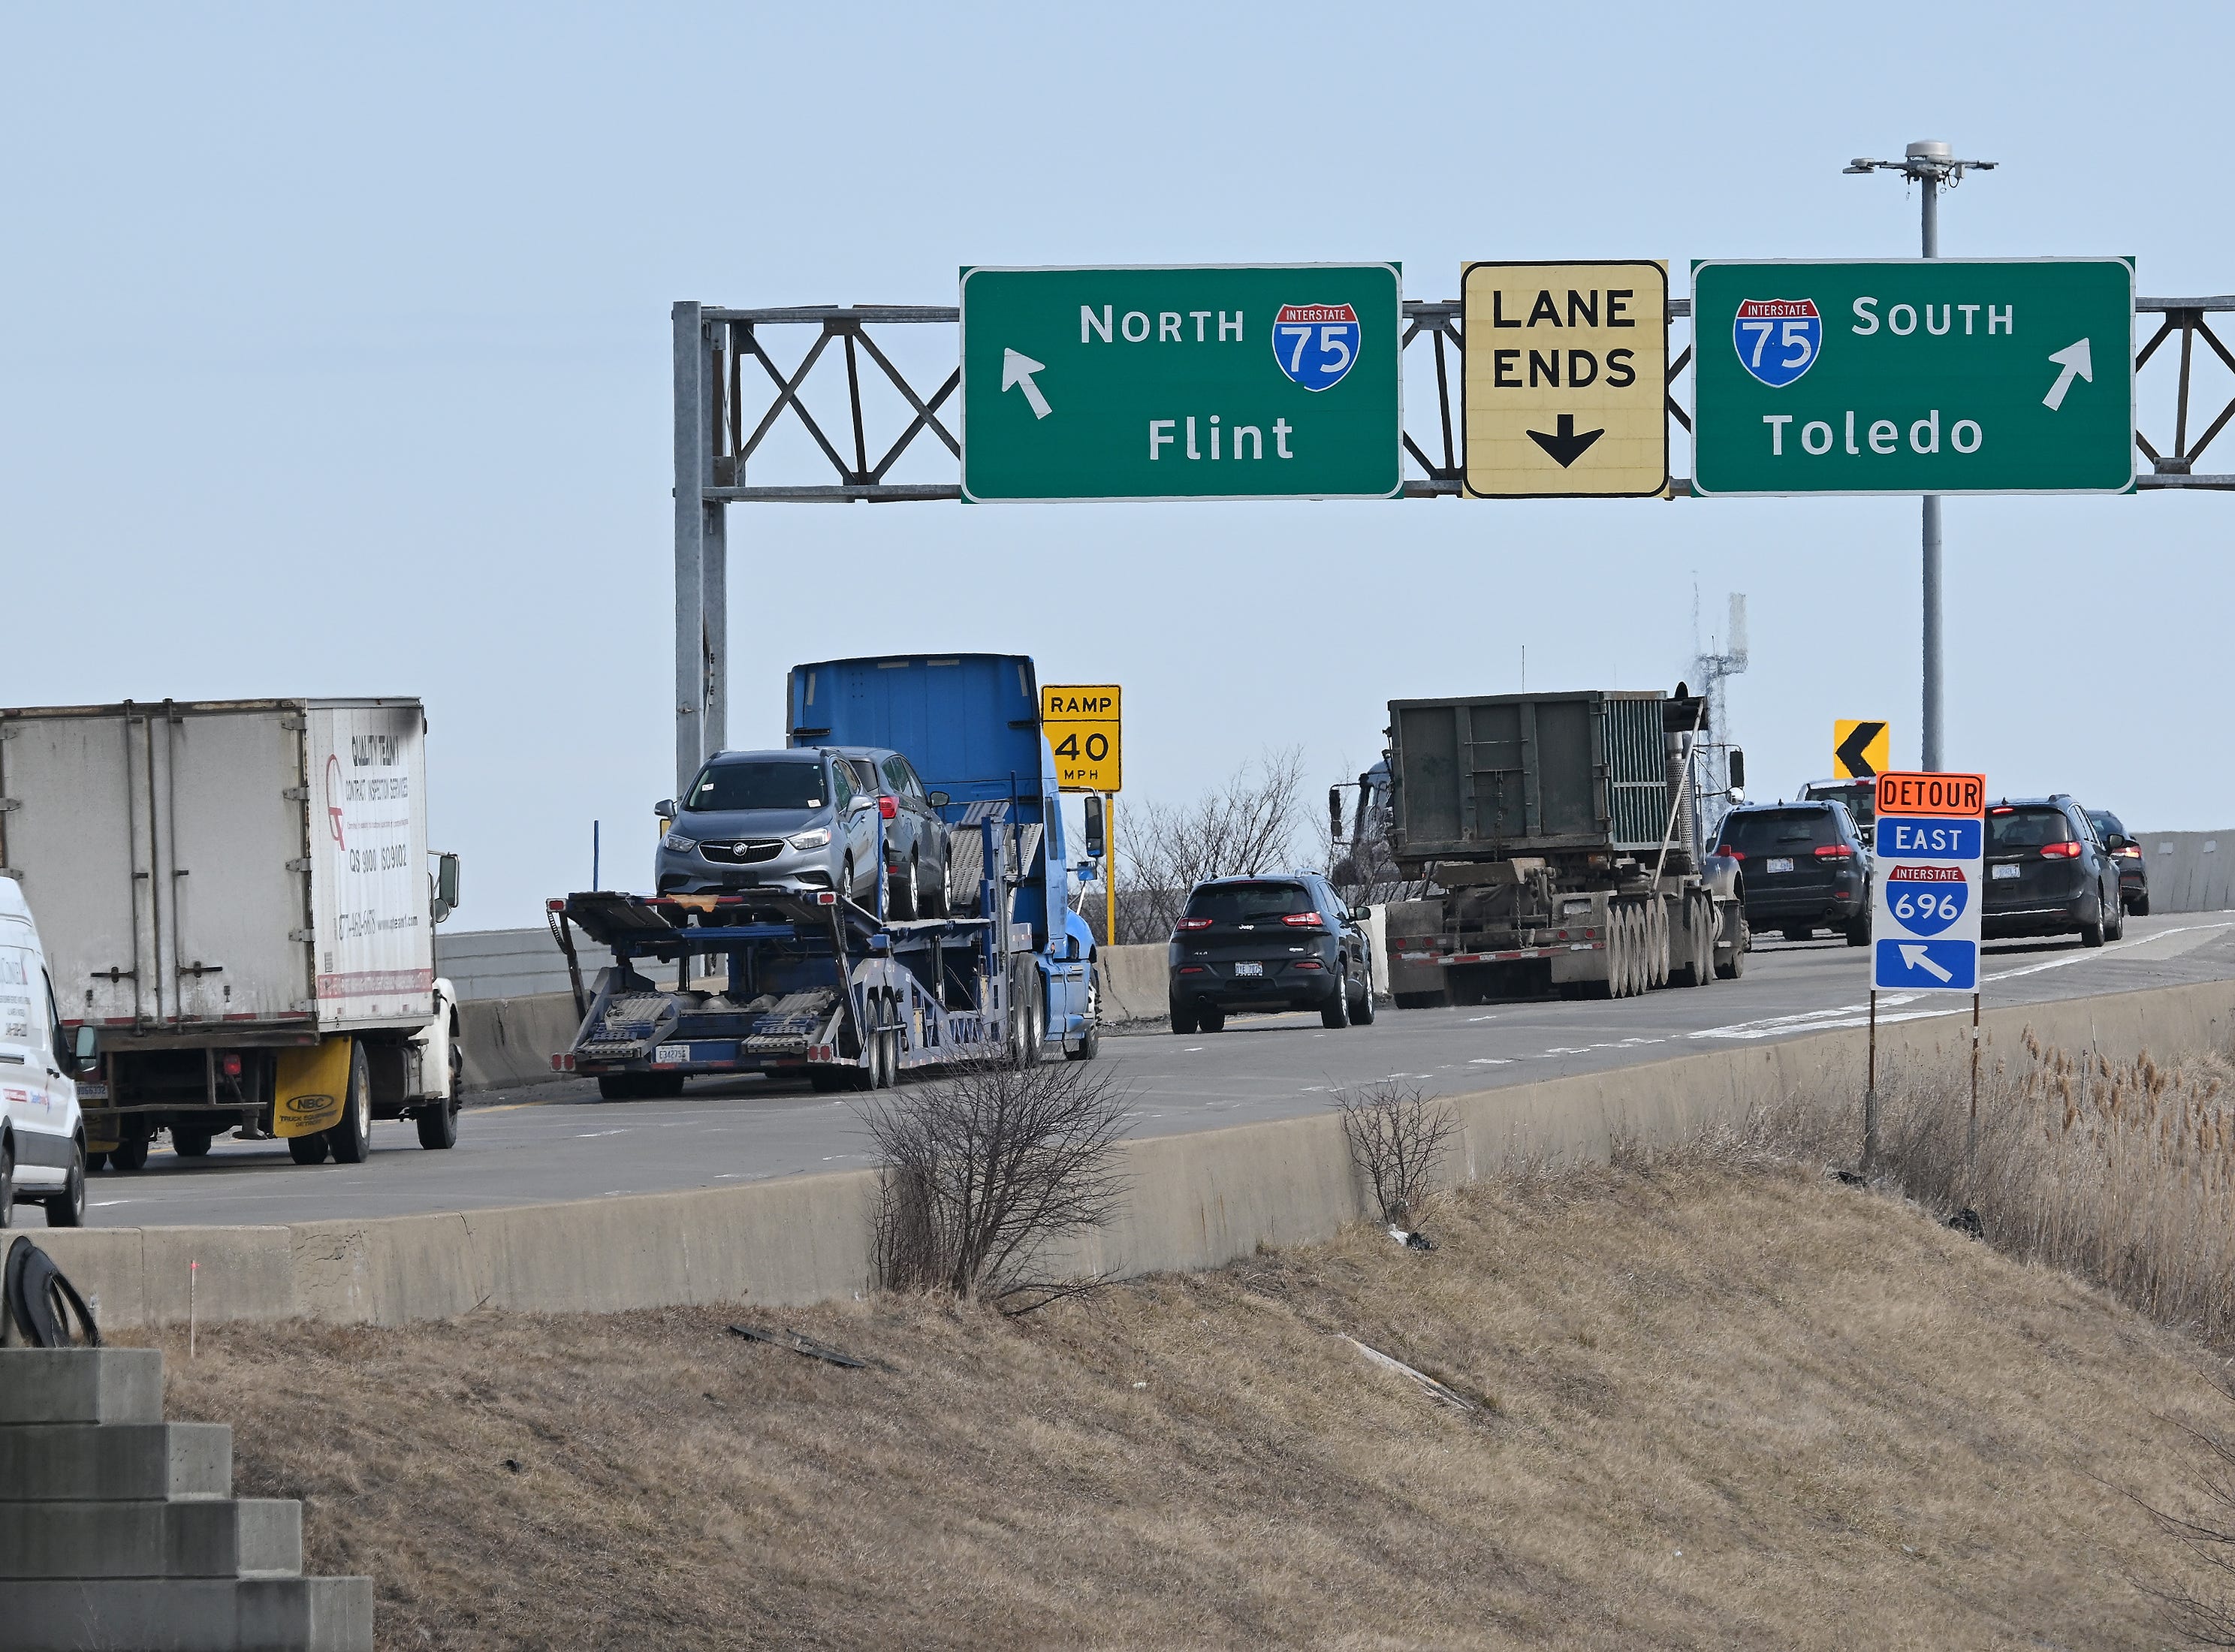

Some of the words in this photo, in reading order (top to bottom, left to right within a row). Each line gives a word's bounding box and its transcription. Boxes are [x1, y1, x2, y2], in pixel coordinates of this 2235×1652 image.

[1286, 309, 1347, 322] INTERSTATE
[1493, 289, 1636, 328] LANE
[1747, 303, 1808, 317] INTERSTATE
[1851, 296, 2013, 336] SOUTH
[1080, 304, 1244, 344] NORTH
[1280, 326, 1350, 373] 75
[1741, 321, 1812, 369] 75
[1493, 348, 1636, 388] ENDS
[1149, 415, 1293, 460] Flint
[1763, 409, 1983, 456] Toledo
[1051, 697, 1112, 713] RAMP
[1054, 733, 1109, 761] 40
[1063, 769, 1099, 780] MPH
[1884, 780, 1977, 808] DETOUR
[1896, 826, 1962, 851] EAST
[1896, 868, 1959, 880] INTERSTATE
[1895, 894, 1959, 921] 696
[297, 1097, 324, 1110] NBC
